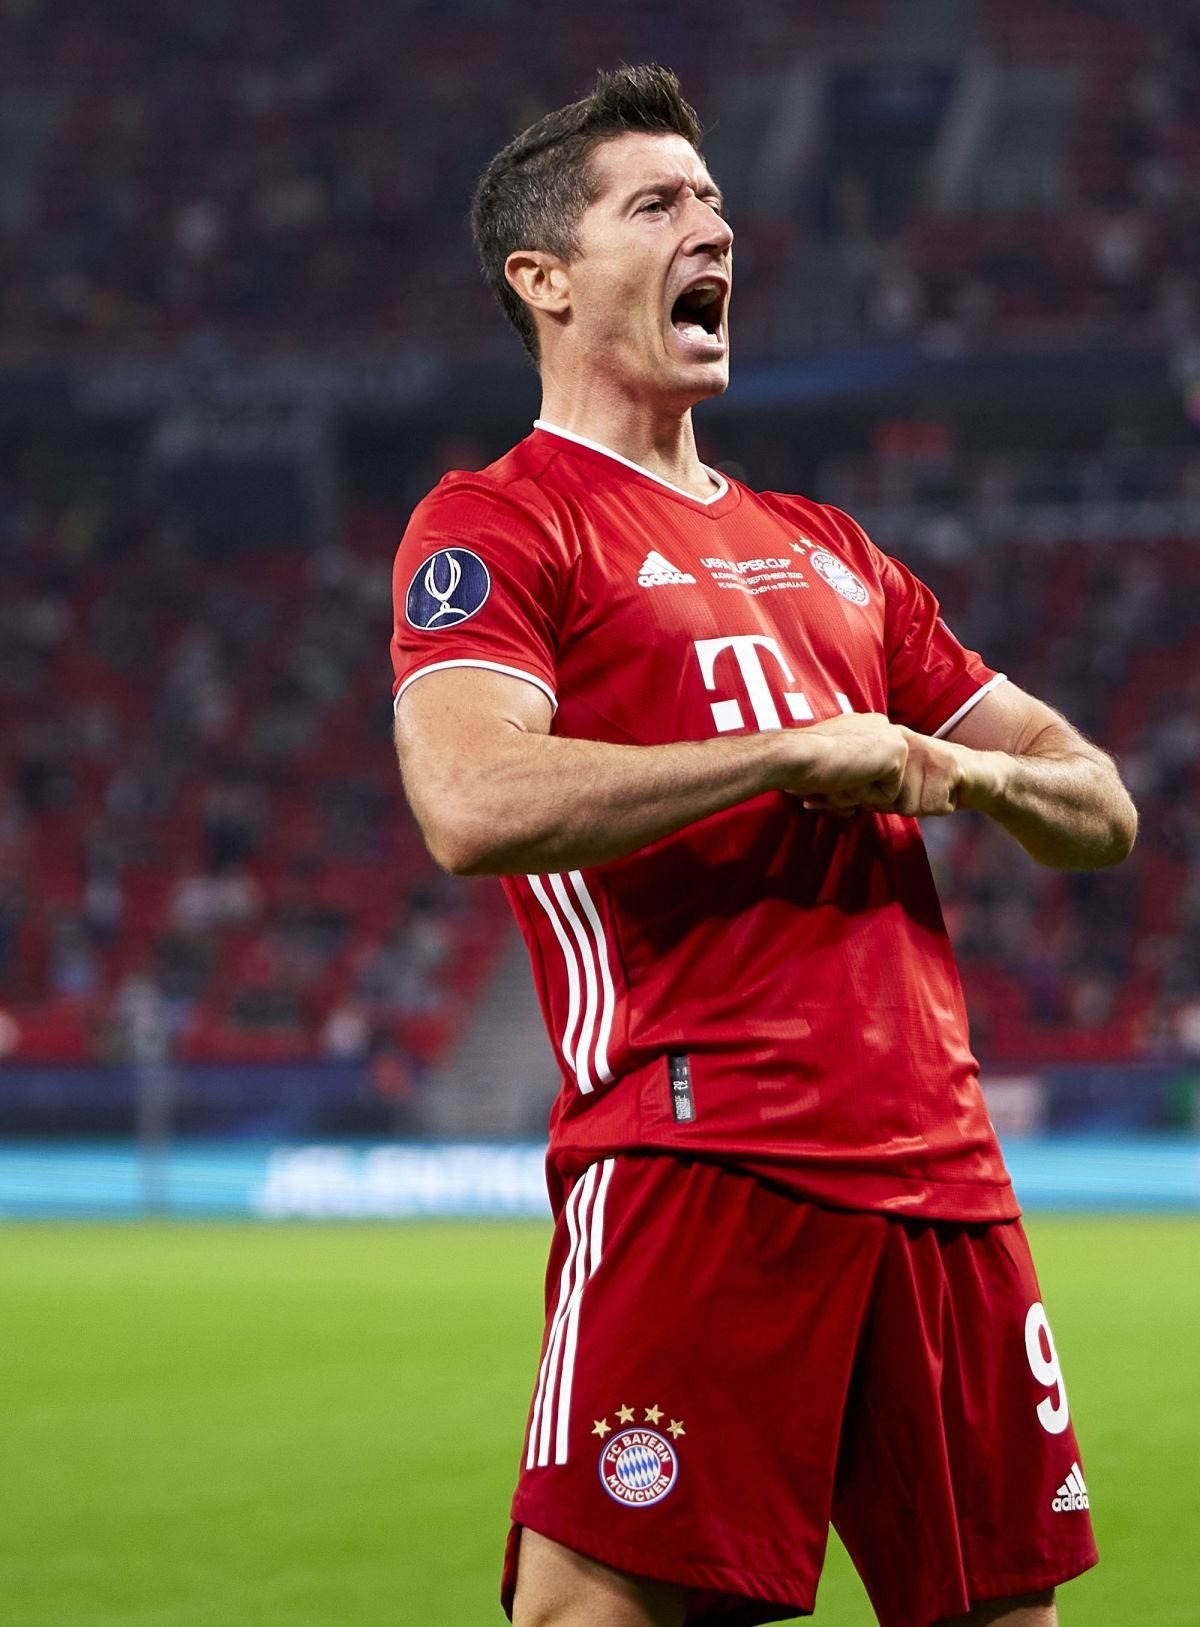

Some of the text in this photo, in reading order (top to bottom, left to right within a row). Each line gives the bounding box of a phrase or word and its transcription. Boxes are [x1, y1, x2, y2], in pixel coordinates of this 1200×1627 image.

[766, 557, 792, 569] CUP
[637, 572, 697, 588] adidas
[747, 572, 787, 584] SEPTEMBER
[1025, 1301, 1070, 1435] 9
[606, 1433, 671, 1463] FC BAYERN
[1052, 1491, 1090, 1513] adida
